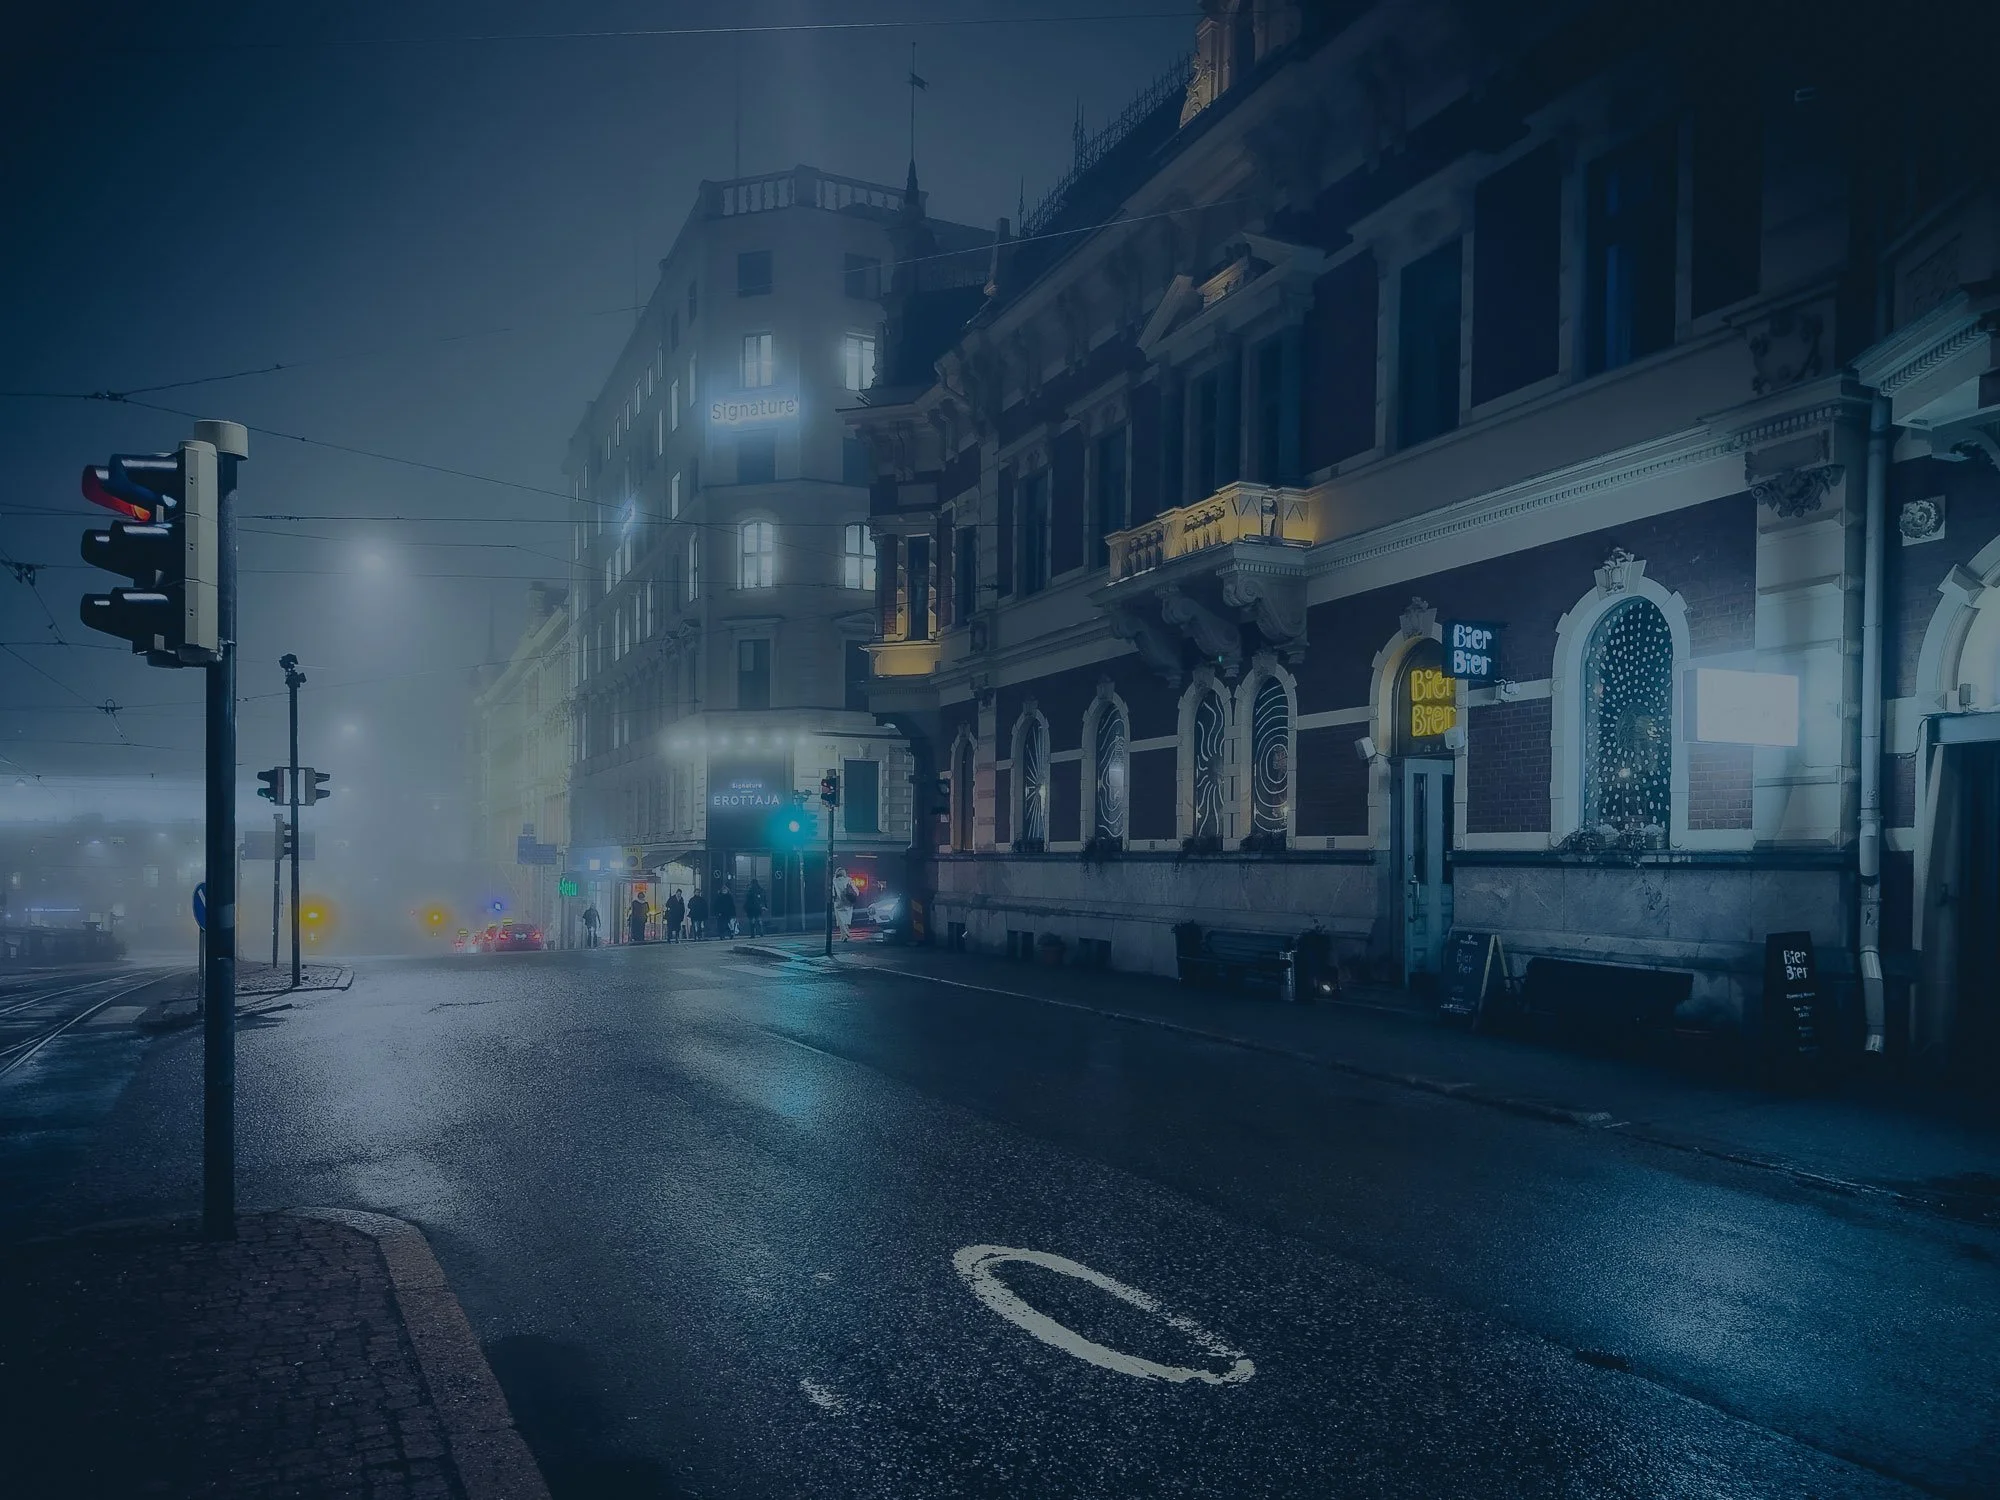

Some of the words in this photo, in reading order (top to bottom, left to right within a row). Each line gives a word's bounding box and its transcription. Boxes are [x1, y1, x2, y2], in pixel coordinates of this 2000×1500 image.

[1453, 624, 1493, 650] Bier
[1453, 650, 1492, 676] Bier
[1411, 670, 1456, 701] Bier
[1412, 705, 1456, 736] Bier
[713, 794, 780, 806] EROTTAJA
[1783, 949, 1808, 965] Bier
[1786, 966, 1808, 980] Bier
